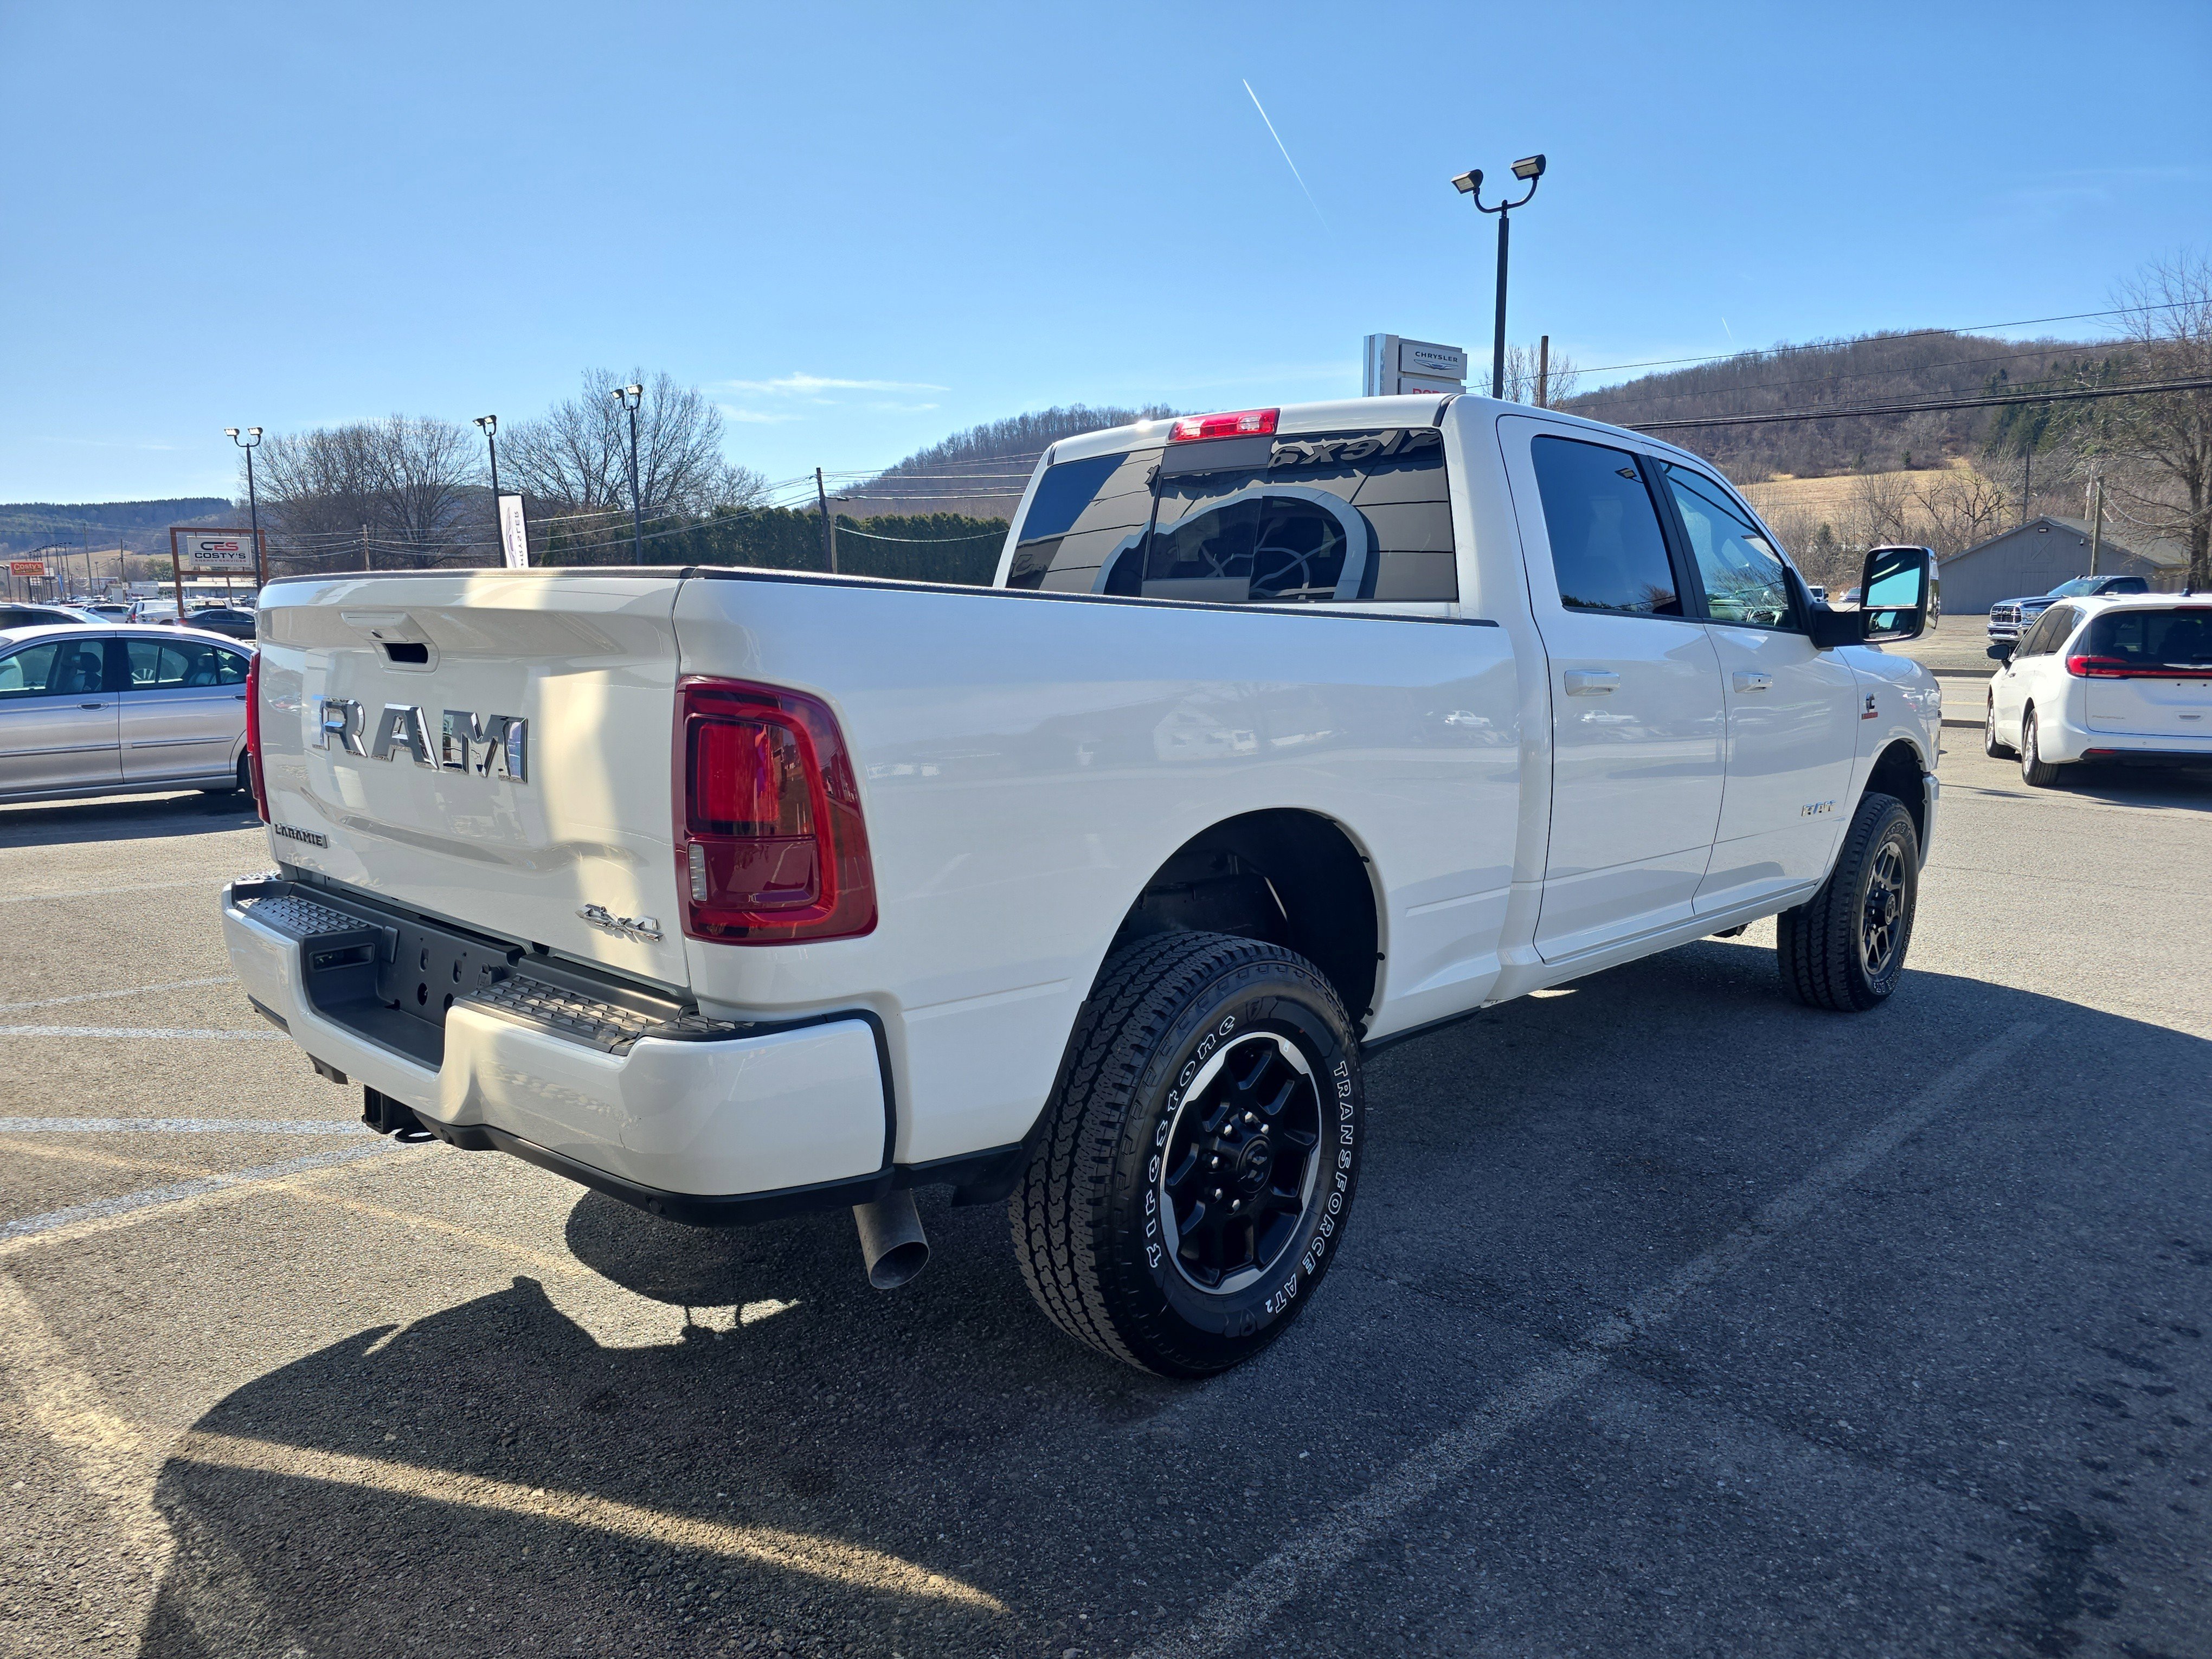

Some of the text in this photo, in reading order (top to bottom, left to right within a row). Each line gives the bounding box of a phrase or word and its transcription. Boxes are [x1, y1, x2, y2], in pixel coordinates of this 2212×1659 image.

[1415, 351, 1458, 363] CHRYSLER
[201, 542, 239, 551] CES
[312, 695, 528, 784] RAM
[274, 823, 327, 848] LARAMIE
[1302, 1062, 1353, 1274] TRANSFORCE
